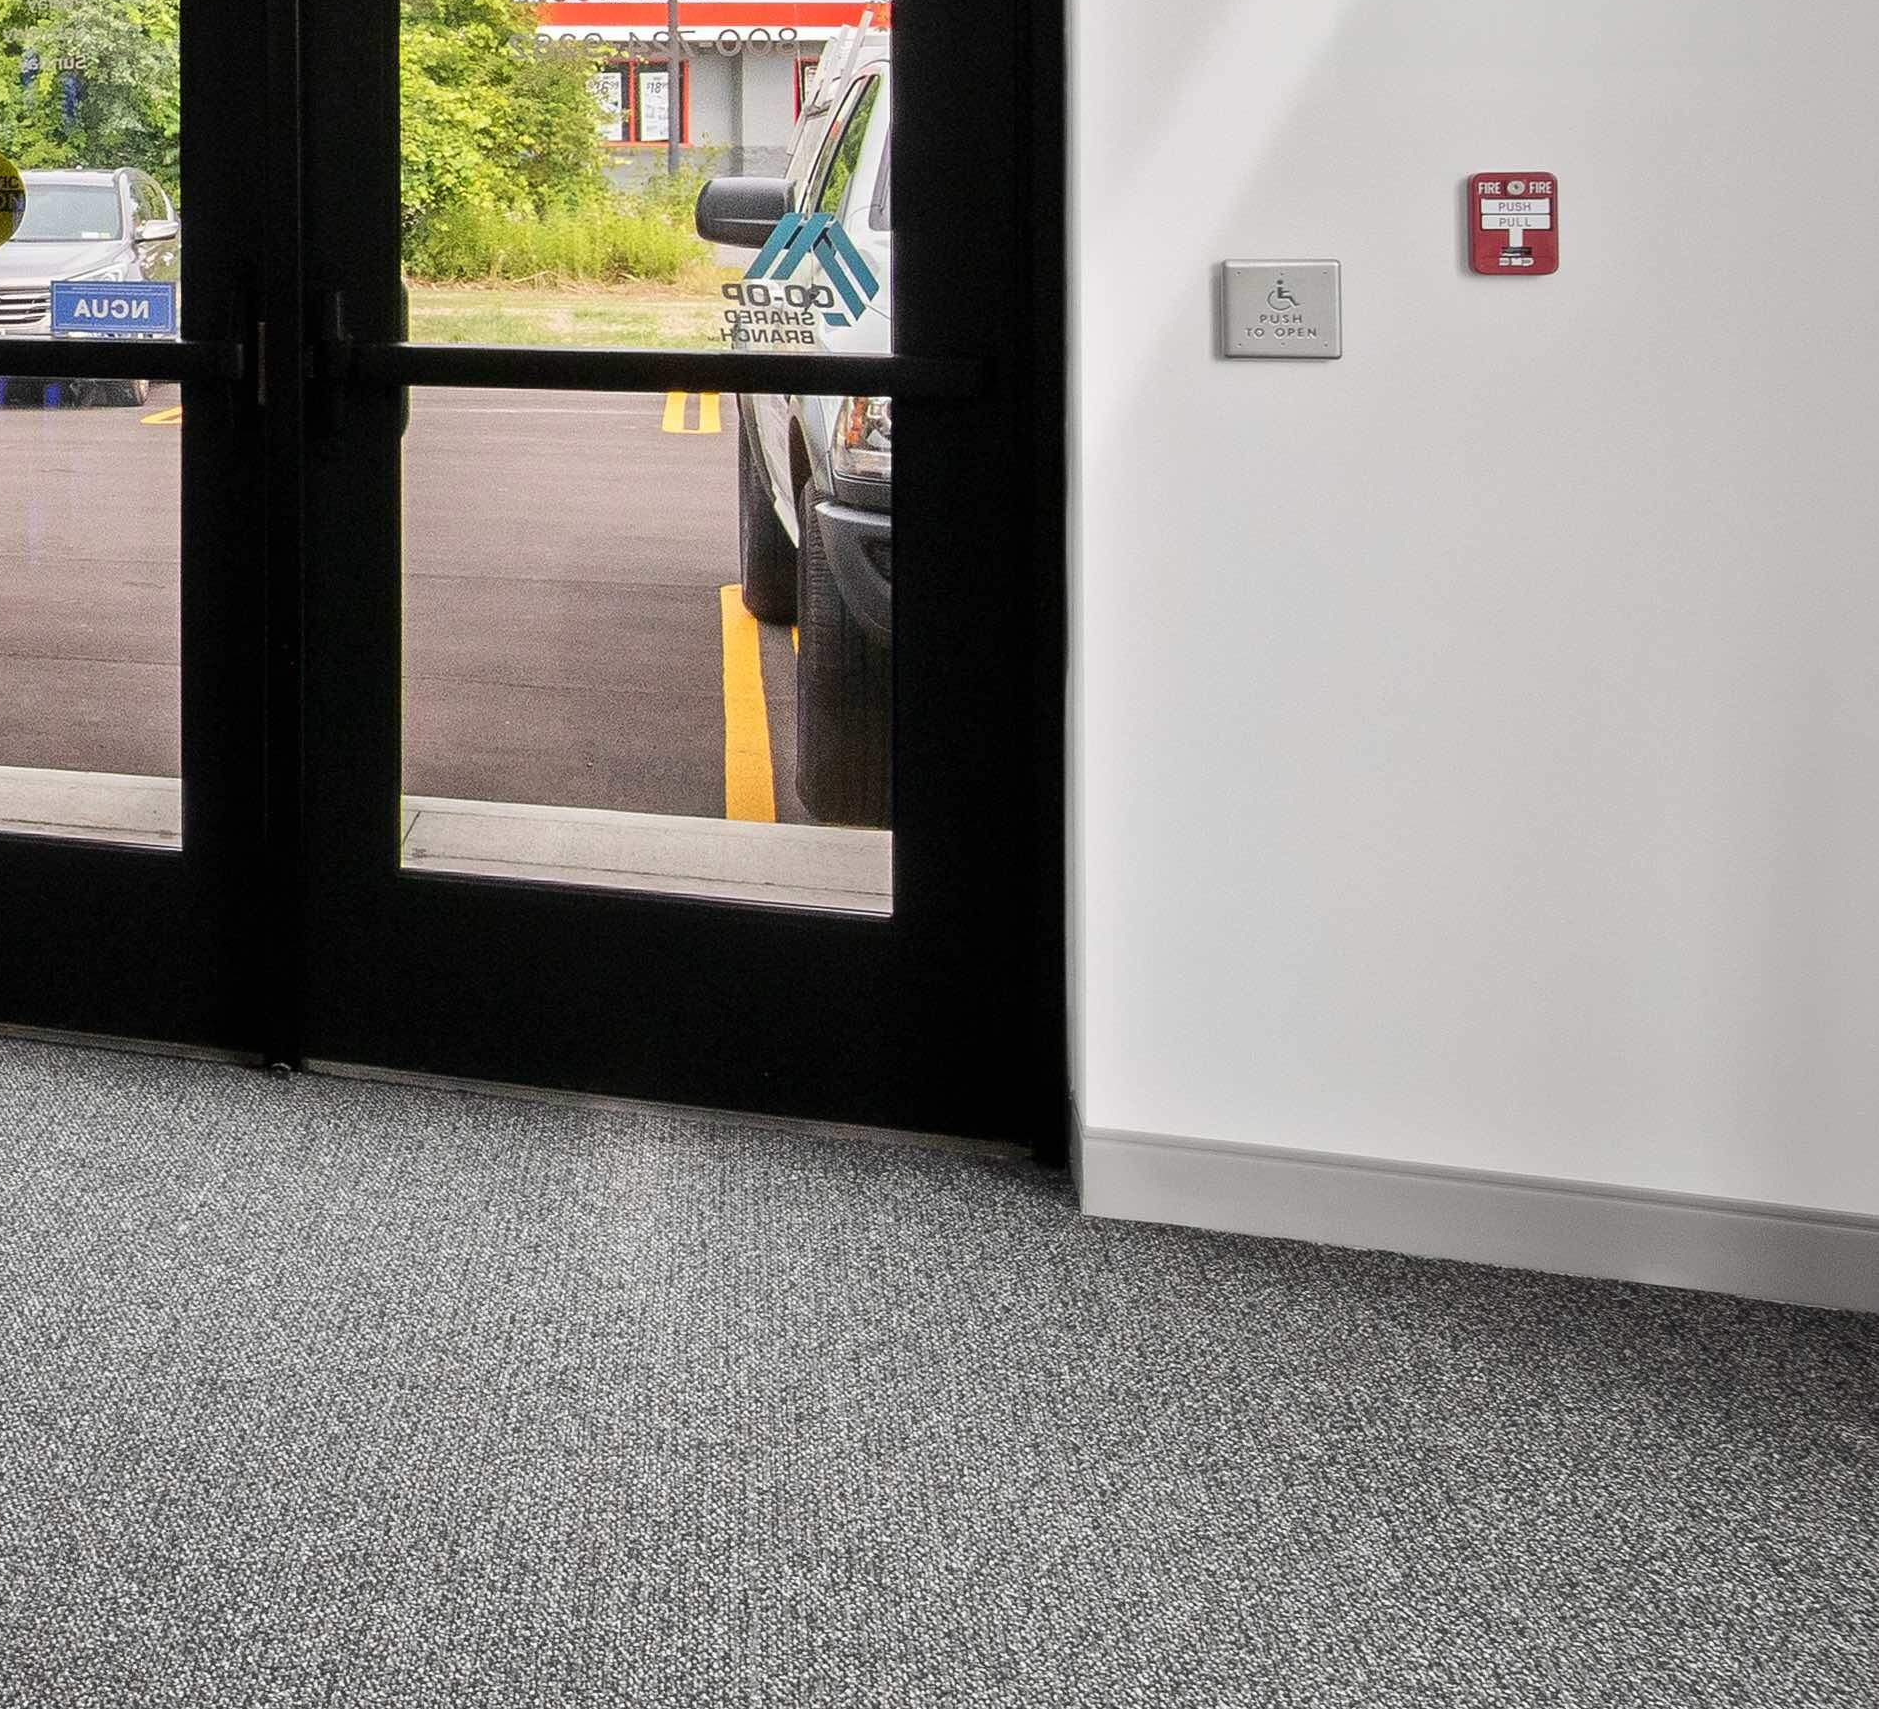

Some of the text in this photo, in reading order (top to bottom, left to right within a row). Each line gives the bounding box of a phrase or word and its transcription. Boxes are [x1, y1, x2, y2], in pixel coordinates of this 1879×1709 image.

[1478, 181, 1553, 195] FIRE FIRE
[1498, 201, 1532, 212] PUSH
[1498, 217, 1532, 228] PULL
[1258, 313, 1303, 324] PUSH
[1245, 327, 1318, 338] TO OPEN
